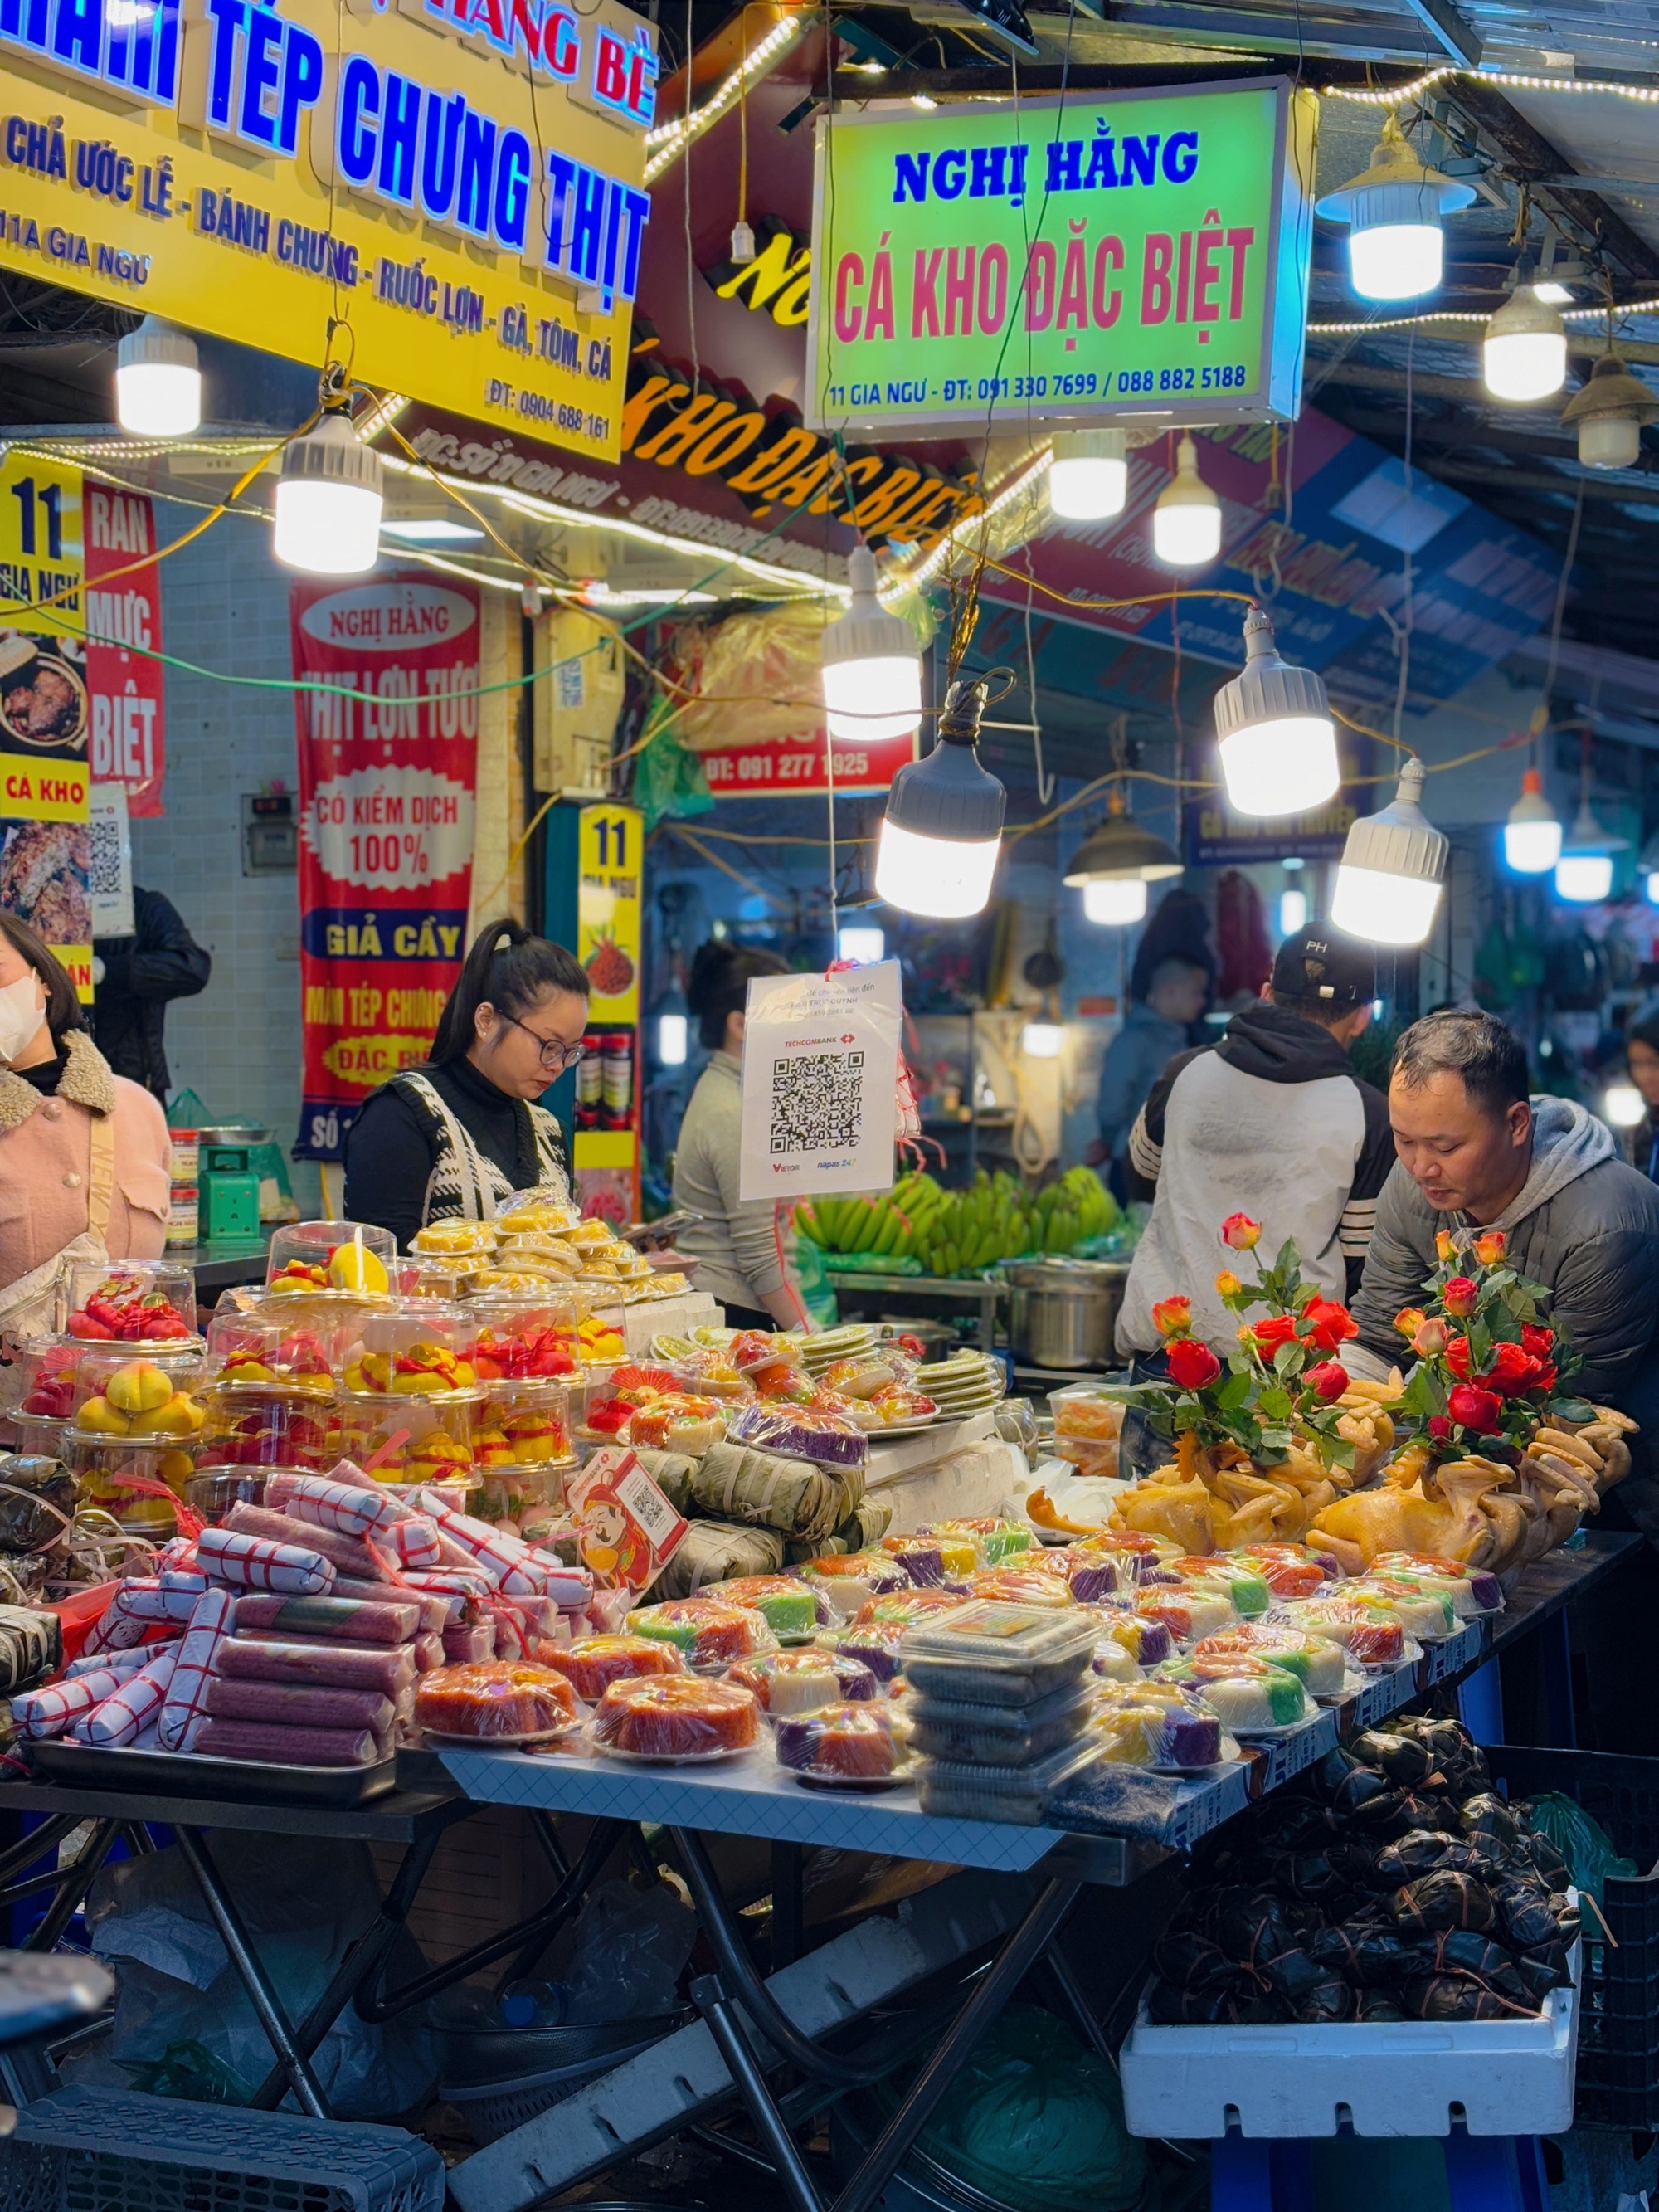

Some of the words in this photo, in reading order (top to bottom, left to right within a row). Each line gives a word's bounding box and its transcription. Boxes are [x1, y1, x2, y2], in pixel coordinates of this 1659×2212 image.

[337, 52, 533, 254] CHƯNG
[544, 148, 651, 314] THỊT
[893, 144, 1029, 207] NGHỊ
[1044, 117, 1199, 192] HẰNG
[5, 115, 67, 180] CHẢ
[139, 155, 174, 218] LỄ
[197, 186, 271, 254] BÁNH
[276, 217, 358, 288] CHƯNG
[377, 256, 439, 315] RUỐC
[442, 281, 484, 336] LỢN
[586, 336, 612, 381] CÁ
[47, 227, 91, 267] GIA
[834, 230, 895, 343] CÁ
[912, 242, 1009, 339] KHO
[1024, 217, 1125, 352] ĐẶC
[1140, 207, 1255, 344] BIỆT
[830, 385, 846, 407] 11
[850, 382, 882, 406] GIA
[886, 376, 930, 404] NGƯ
[942, 378, 973, 402] ĐT:
[978, 376, 1010, 401] 091
[1014, 375, 1048, 399] 330
[1052, 373, 1097, 397] 7699
[1117, 370, 1154, 394] 088
[1159, 368, 1195, 392] 882
[1200, 364, 1246, 389] 5188
[518, 388, 555, 421] 0904
[557, 407, 584, 431] 688
[586, 412, 610, 441] 161
[11, 475, 62, 561] 11
[86, 589, 152, 661] MỰC
[329, 608, 382, 643] NGHỊ
[387, 590, 450, 636] HẰNG
[363, 664, 419, 757] LỢN
[6, 772, 32, 800] CÁ
[40, 778, 85, 806] KHO
[737, 754, 773, 780] 091
[777, 753, 815, 779] 277
[822, 752, 869, 777] 1925
[316, 790, 345, 824] CÓ
[353, 784, 404, 825] KIỂM
[411, 796, 459, 831] DỊCH
[349, 833, 428, 874] 100%
[593, 817, 626, 867] 11
[326, 913, 382, 957] GIẢ
[394, 915, 460, 957] CẦY
[1306, 940, 1328, 953] PH
[349, 981, 382, 1029] TÉP
[784, 1036, 838, 1048] TECHCOMBANK
[311, 1107, 339, 1149] SỐ
[816, 1159, 841, 1170] napas
[841, 1157, 857, 1167] 247
